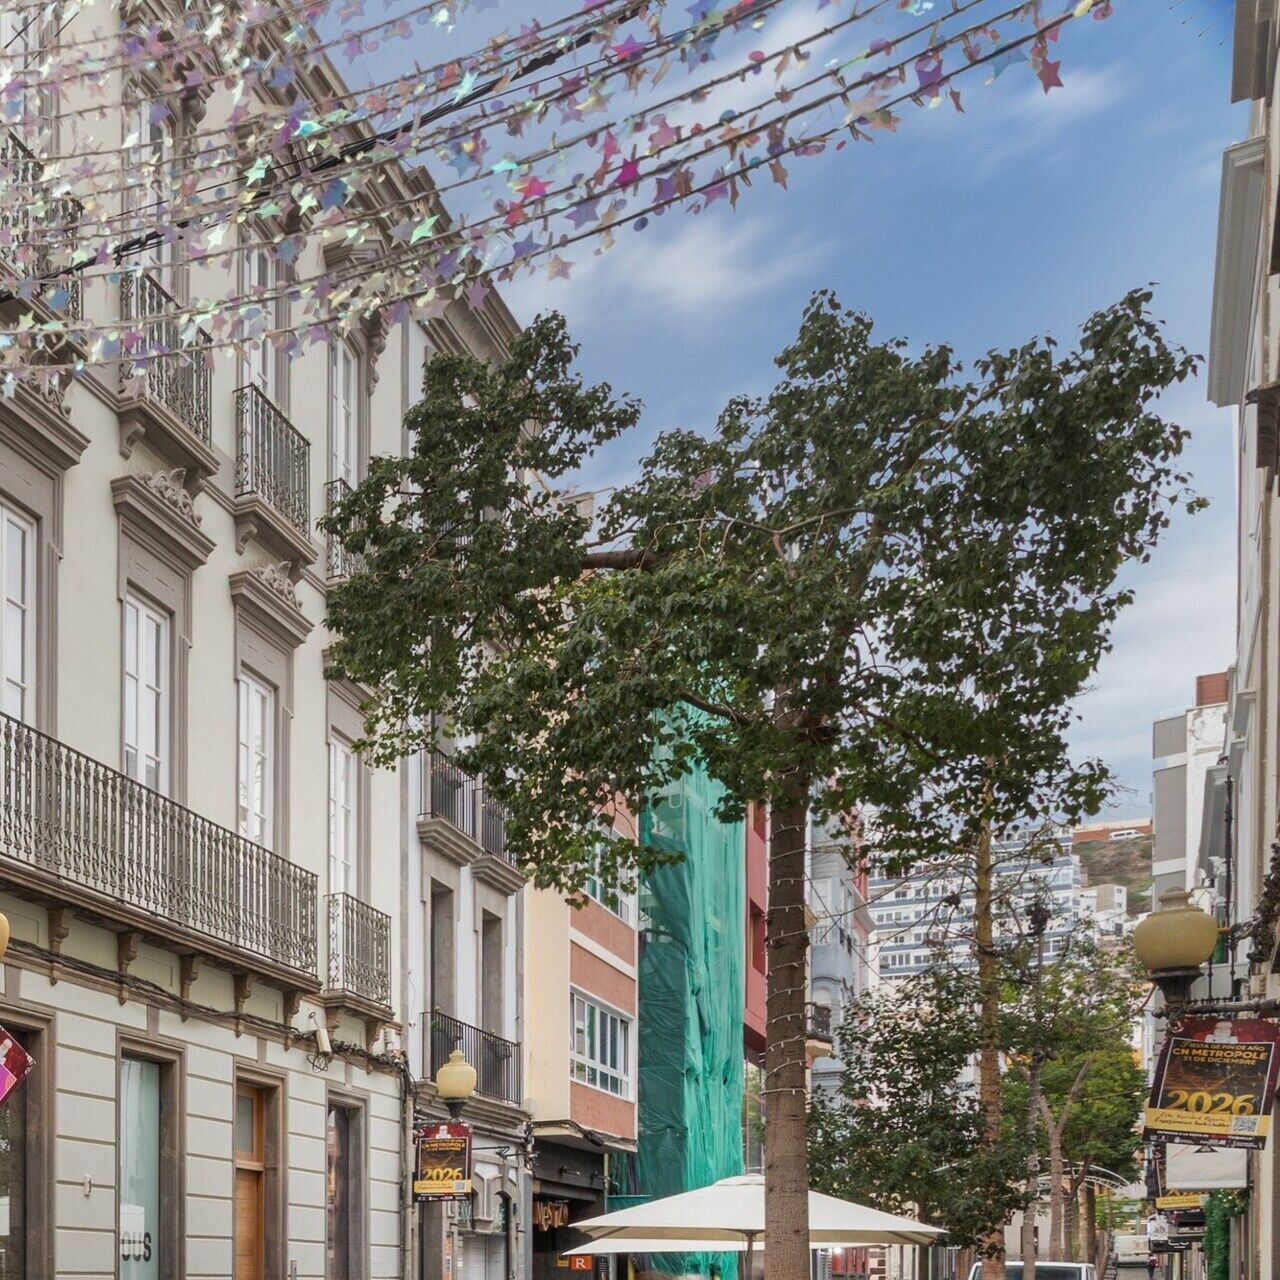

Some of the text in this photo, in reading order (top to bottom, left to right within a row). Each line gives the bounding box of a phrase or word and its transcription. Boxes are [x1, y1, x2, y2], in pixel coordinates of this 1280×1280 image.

[1172, 1048, 1268, 1060] CN METROPOLE
[1207, 1057, 1257, 1066] DICIEMBRE
[1164, 1089, 1255, 1116] 2026
[422, 1167, 463, 1181] 2026
[120, 1231, 152, 1262] OUS
[575, 1257, 586, 1269] R
